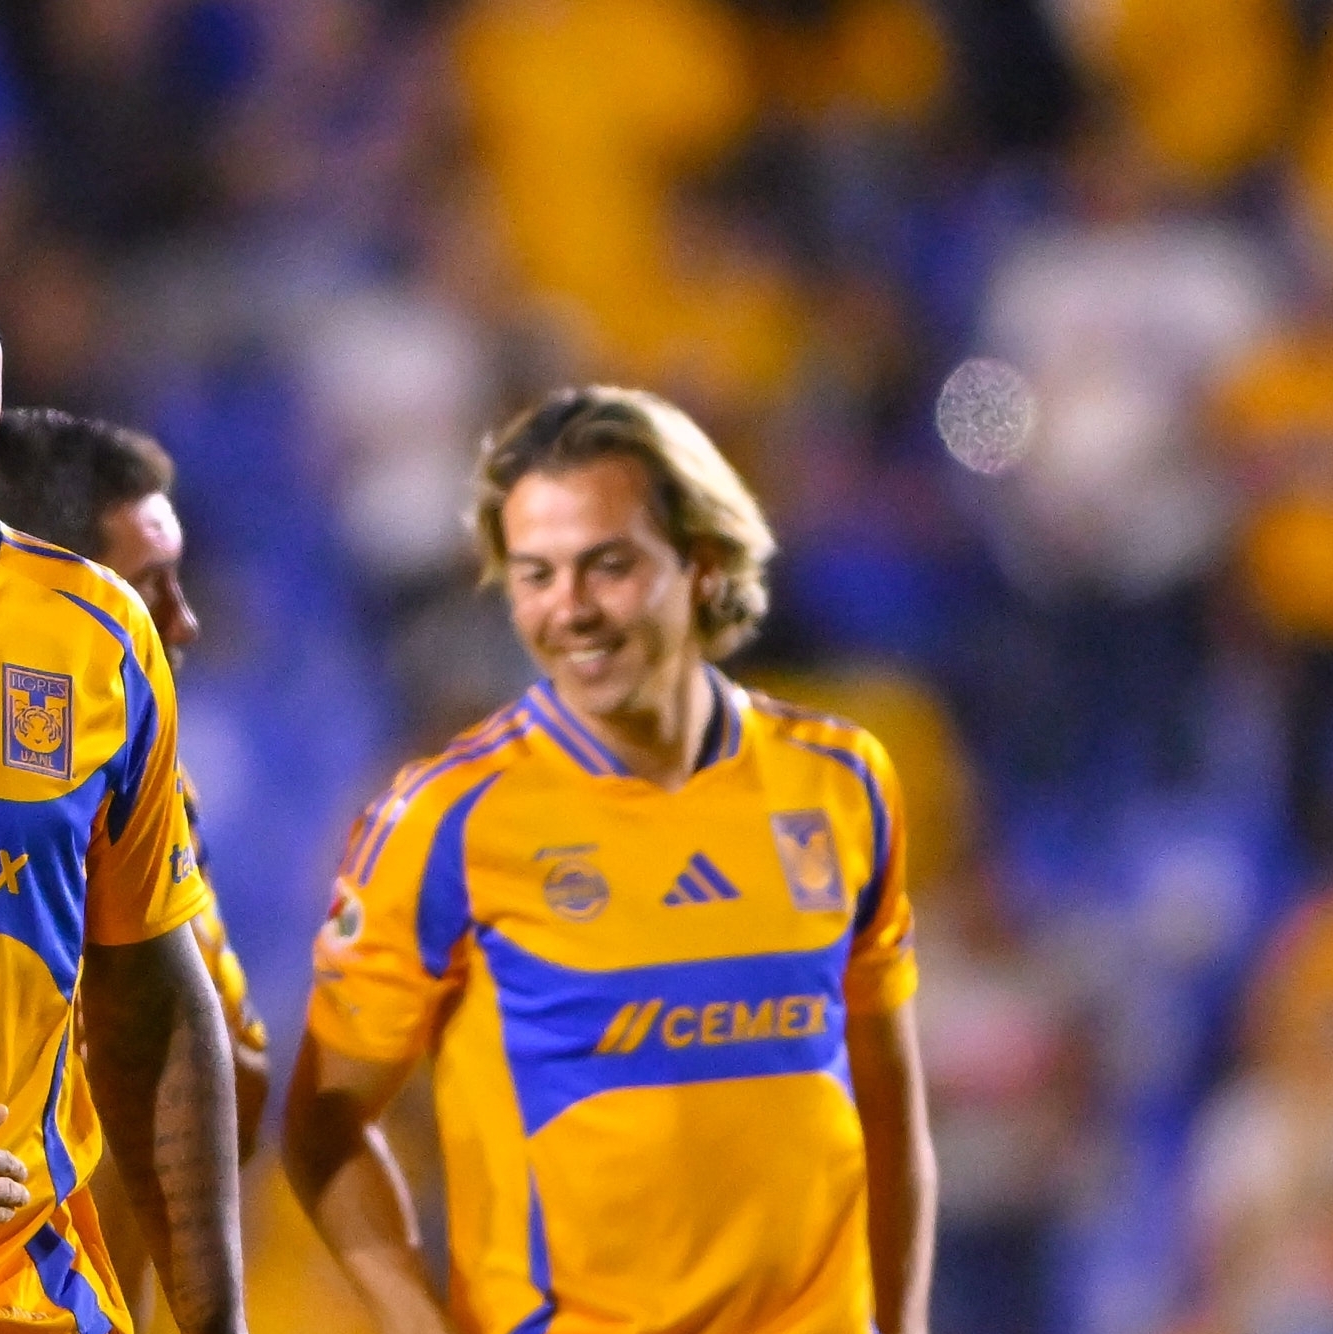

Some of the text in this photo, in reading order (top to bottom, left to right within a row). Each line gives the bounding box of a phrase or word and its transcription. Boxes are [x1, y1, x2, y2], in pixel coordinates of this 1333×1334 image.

[11, 673, 65, 697] TIGRES
[20, 750, 54, 767] UANL
[661, 996, 829, 1048] CEMEX
